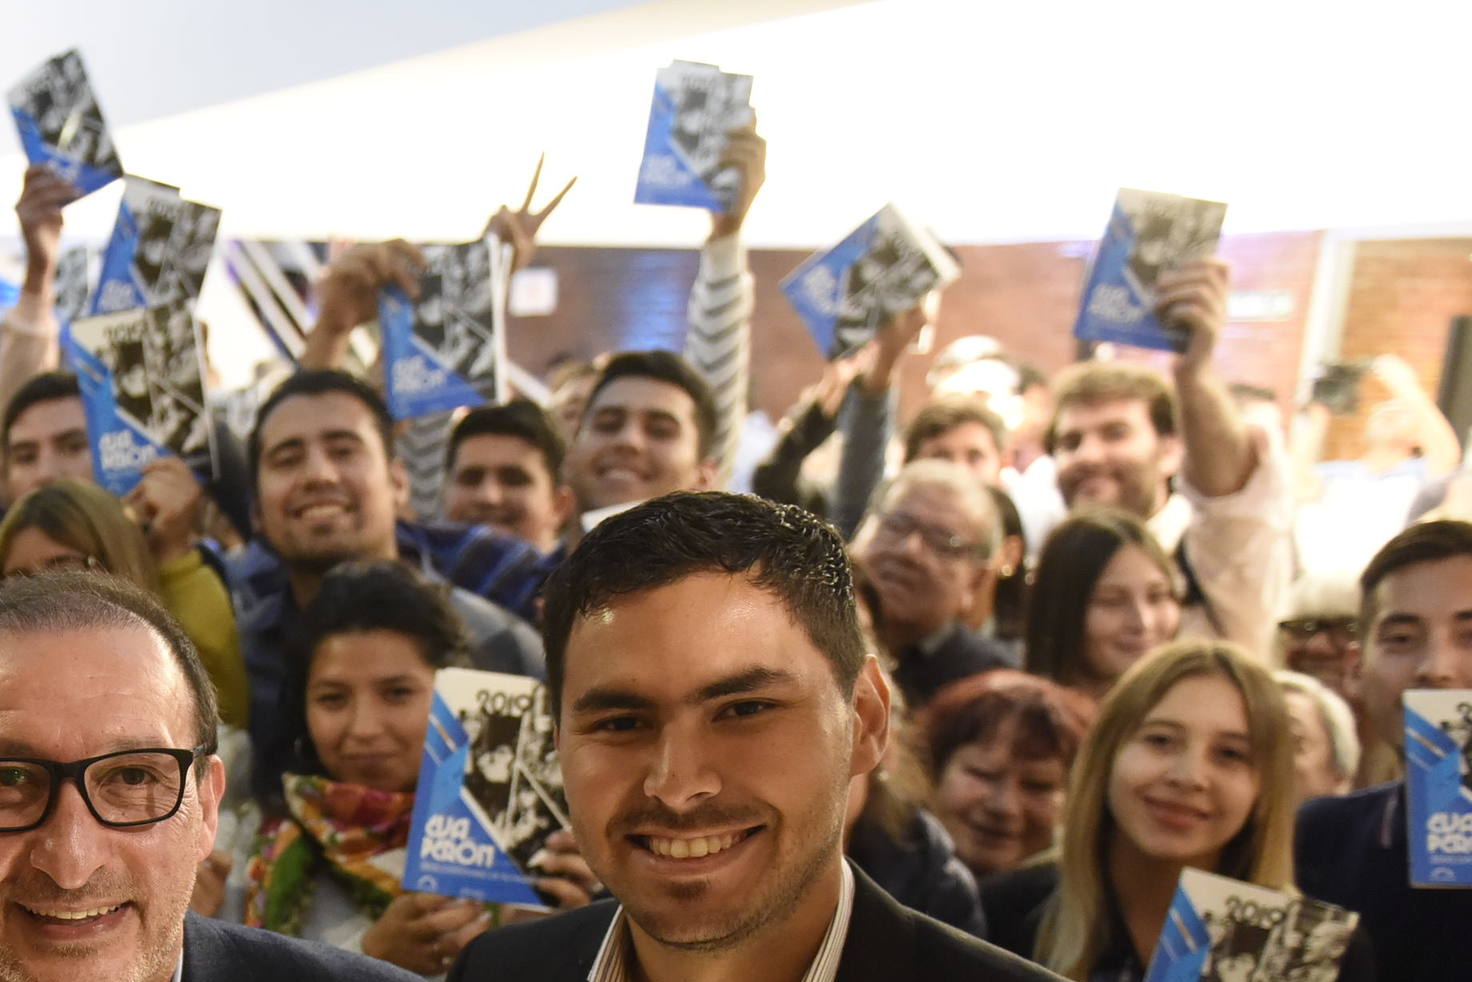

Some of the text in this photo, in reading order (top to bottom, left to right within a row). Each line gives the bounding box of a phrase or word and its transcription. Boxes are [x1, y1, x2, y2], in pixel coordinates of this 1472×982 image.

[477, 689, 533, 718] 2019
[425, 813, 471, 840] EVA
[419, 834, 496, 868] PERÓN
